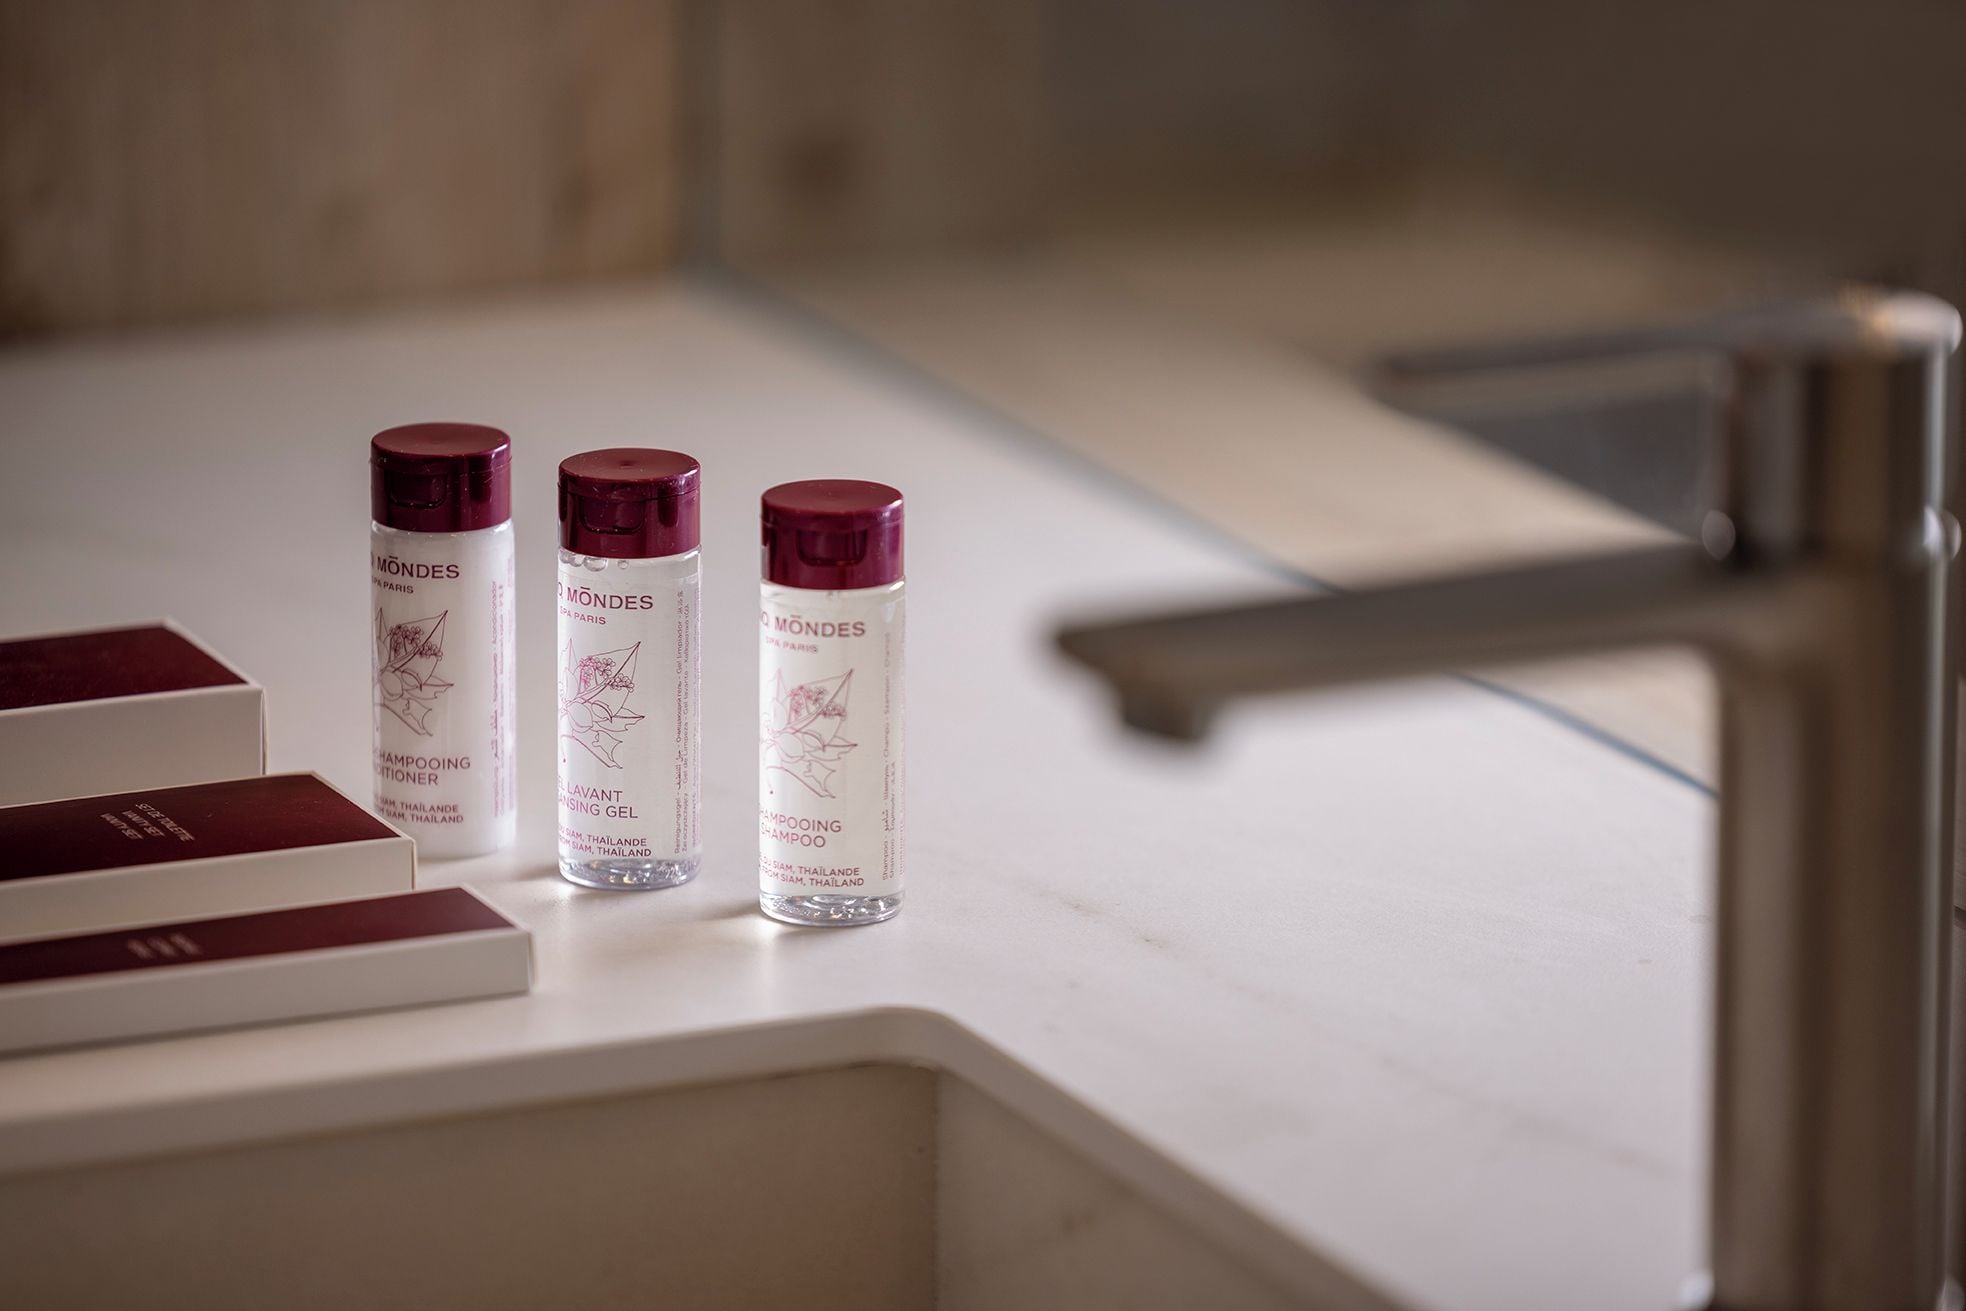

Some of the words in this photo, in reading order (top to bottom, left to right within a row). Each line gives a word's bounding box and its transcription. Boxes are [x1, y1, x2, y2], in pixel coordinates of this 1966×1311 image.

[383, 581, 414, 594] PARIS
[574, 611, 606, 625] PARIS
[782, 640, 819, 654] PARIS
[376, 750, 471, 770] HAMPOOING
[567, 781, 623, 803] LAVANT
[605, 805, 638, 819] GEL
[587, 834, 647, 847] THAÏLANDE
[572, 842, 595, 855] SIAM,
[598, 846, 652, 857] THAÏLAND
[798, 864, 860, 877] THAÏLANDE
[780, 874, 806, 887] SIAM,
[809, 877, 865, 888] THAÏLAND
